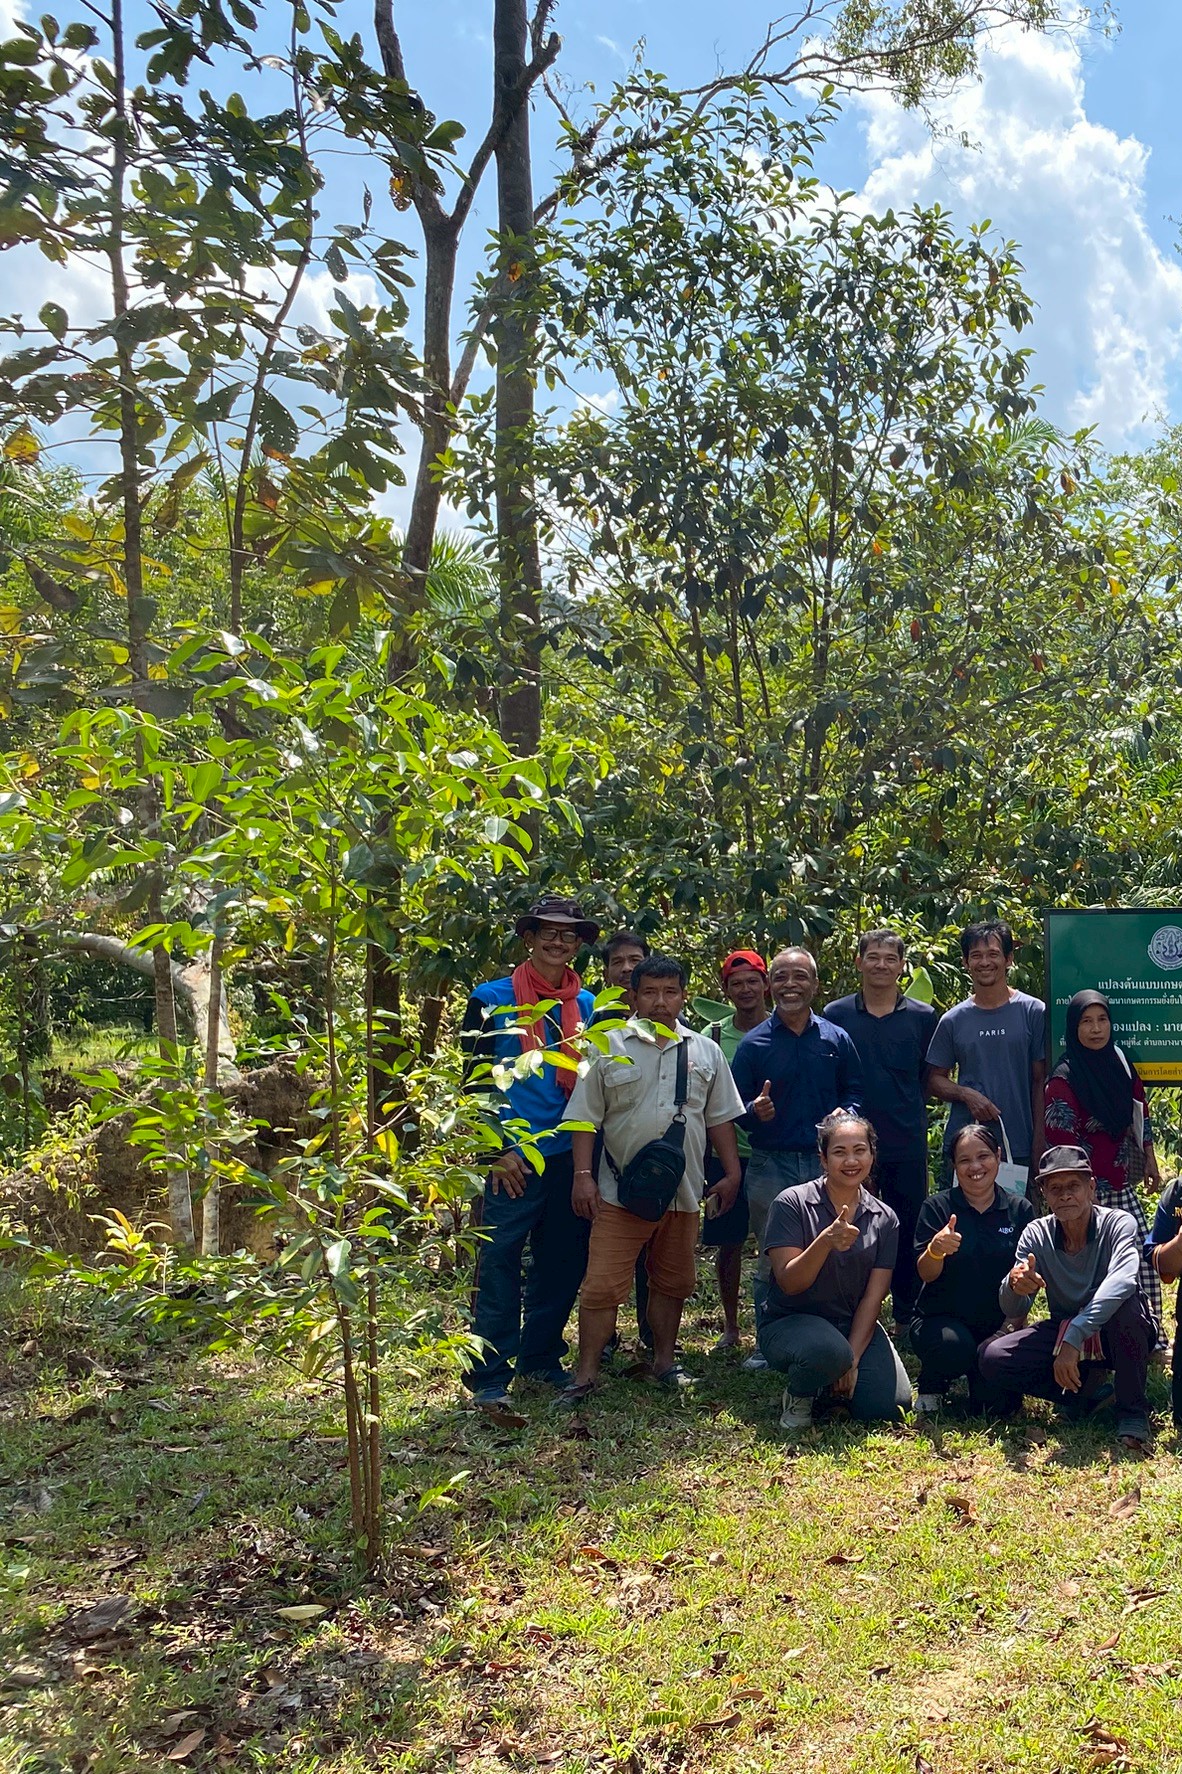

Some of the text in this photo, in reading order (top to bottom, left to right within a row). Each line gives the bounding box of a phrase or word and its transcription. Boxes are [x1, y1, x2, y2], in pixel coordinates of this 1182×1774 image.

[1112, 1020, 1151, 1032] องแปลง
[979, 1028, 1006, 1037] PARIS
